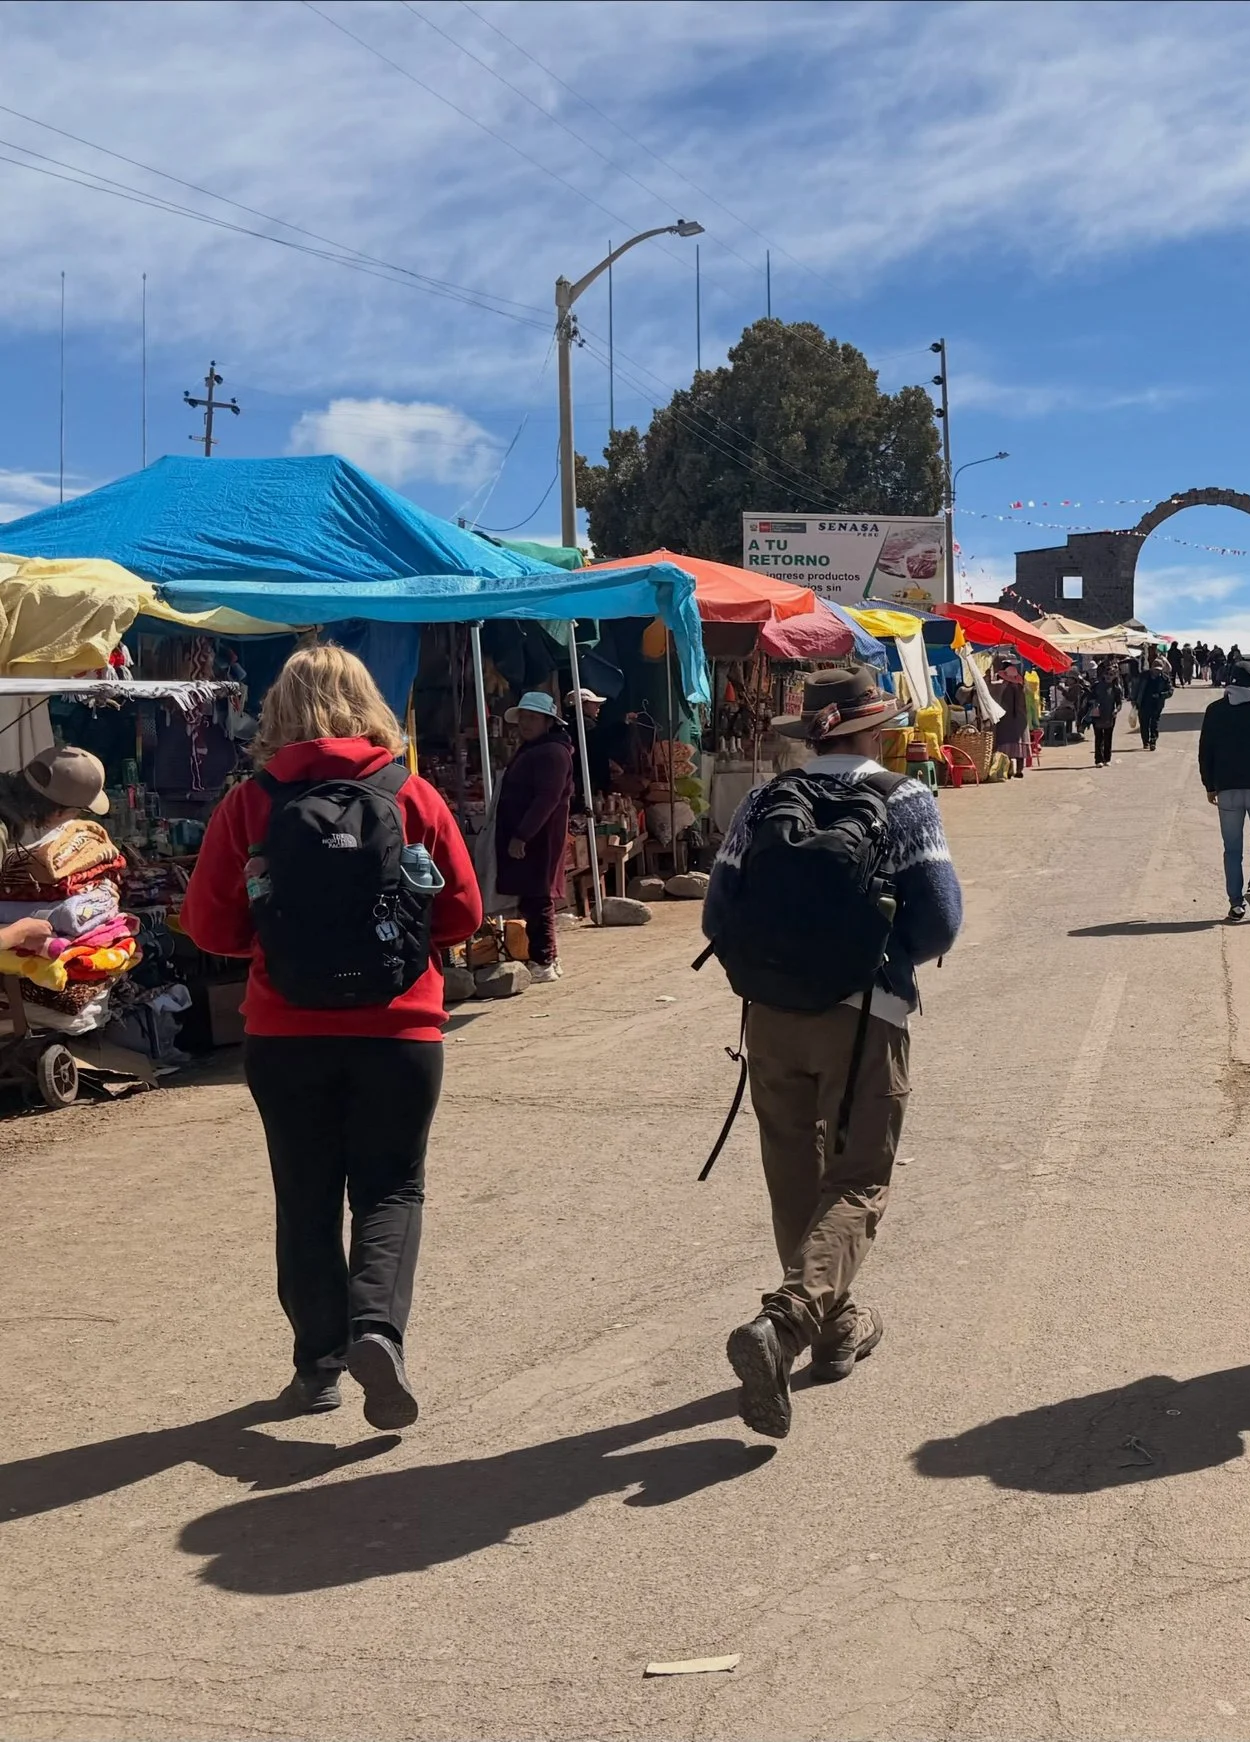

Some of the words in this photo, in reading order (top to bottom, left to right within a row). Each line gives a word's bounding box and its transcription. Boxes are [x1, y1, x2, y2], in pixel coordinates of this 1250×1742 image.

[818, 522, 879, 532] SENASA
[748, 539, 760, 551] A
[765, 540, 788, 551] TU
[748, 554, 831, 567] RETORNO
[807, 571, 860, 582] productos
[826, 582, 842, 592] sin
